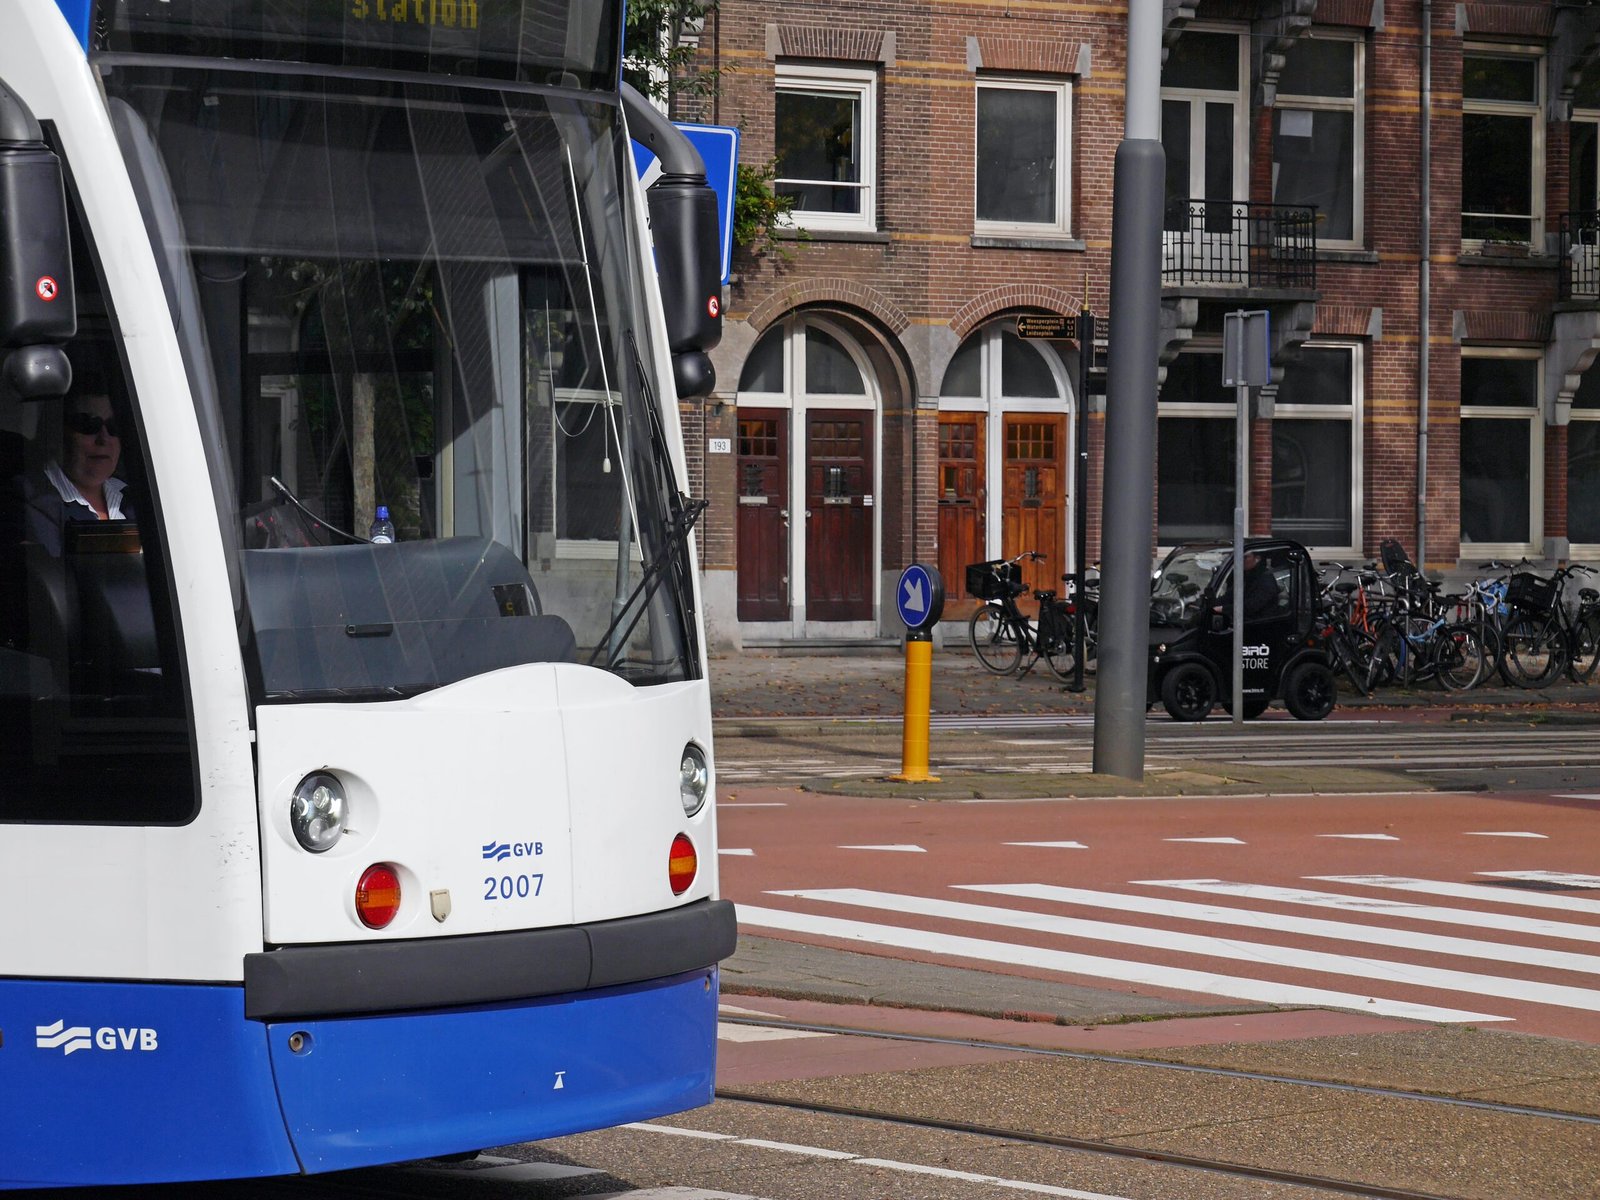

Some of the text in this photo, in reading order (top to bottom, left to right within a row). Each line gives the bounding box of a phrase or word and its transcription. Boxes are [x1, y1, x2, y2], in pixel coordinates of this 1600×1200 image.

[714, 441, 726, 451] 193
[513, 841, 543, 857] GVB
[484, 873, 544, 900] 2007
[95, 1026, 159, 1051] GVB
